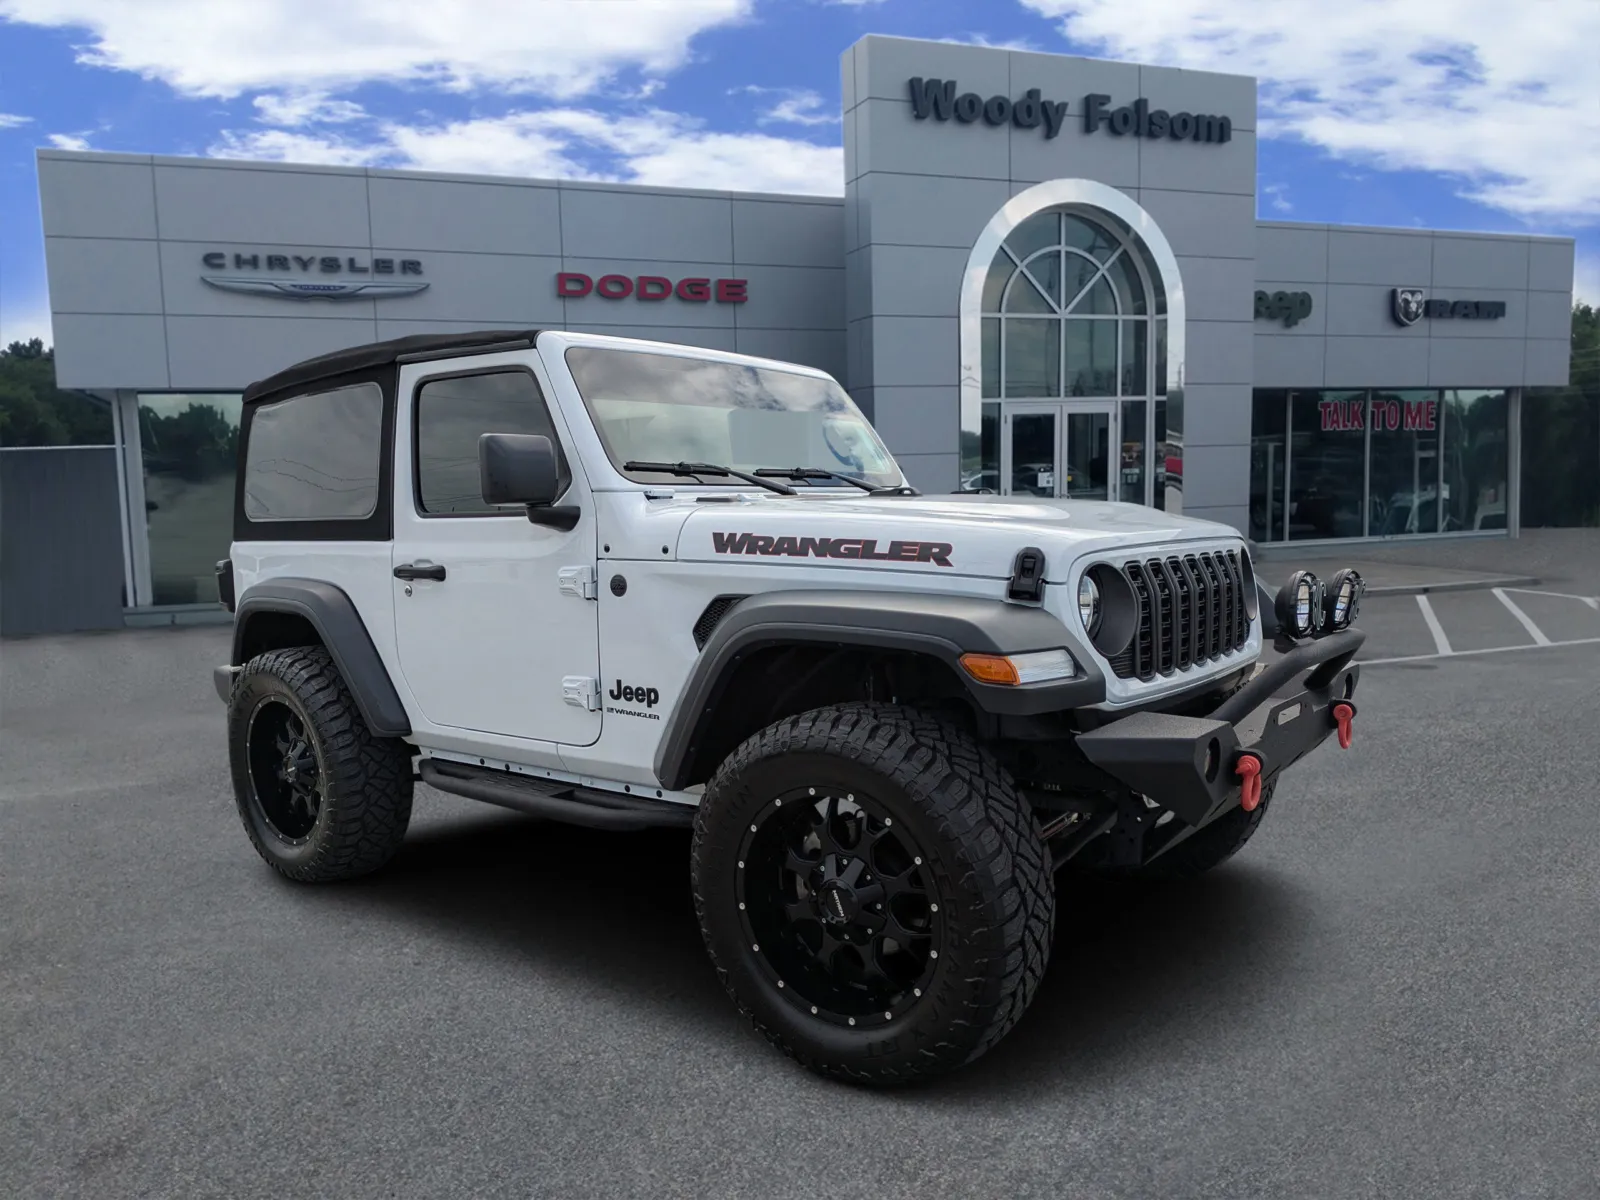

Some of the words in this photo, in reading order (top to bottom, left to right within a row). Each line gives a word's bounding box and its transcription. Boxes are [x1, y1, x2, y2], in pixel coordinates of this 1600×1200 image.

[908, 76, 1069, 139] Woody
[1083, 93, 1232, 143] Folsom
[202, 251, 424, 275] CHRYSLER
[556, 272, 749, 303] DODGE
[1253, 290, 1313, 328] eep
[1425, 299, 1506, 319] RAM
[1319, 401, 1365, 431] TALK
[1370, 400, 1400, 431] TO
[1403, 401, 1436, 431] ME
[712, 532, 954, 567] WRANGLER
[609, 679, 660, 708] Jeep
[614, 707, 660, 721] WRANGLER
